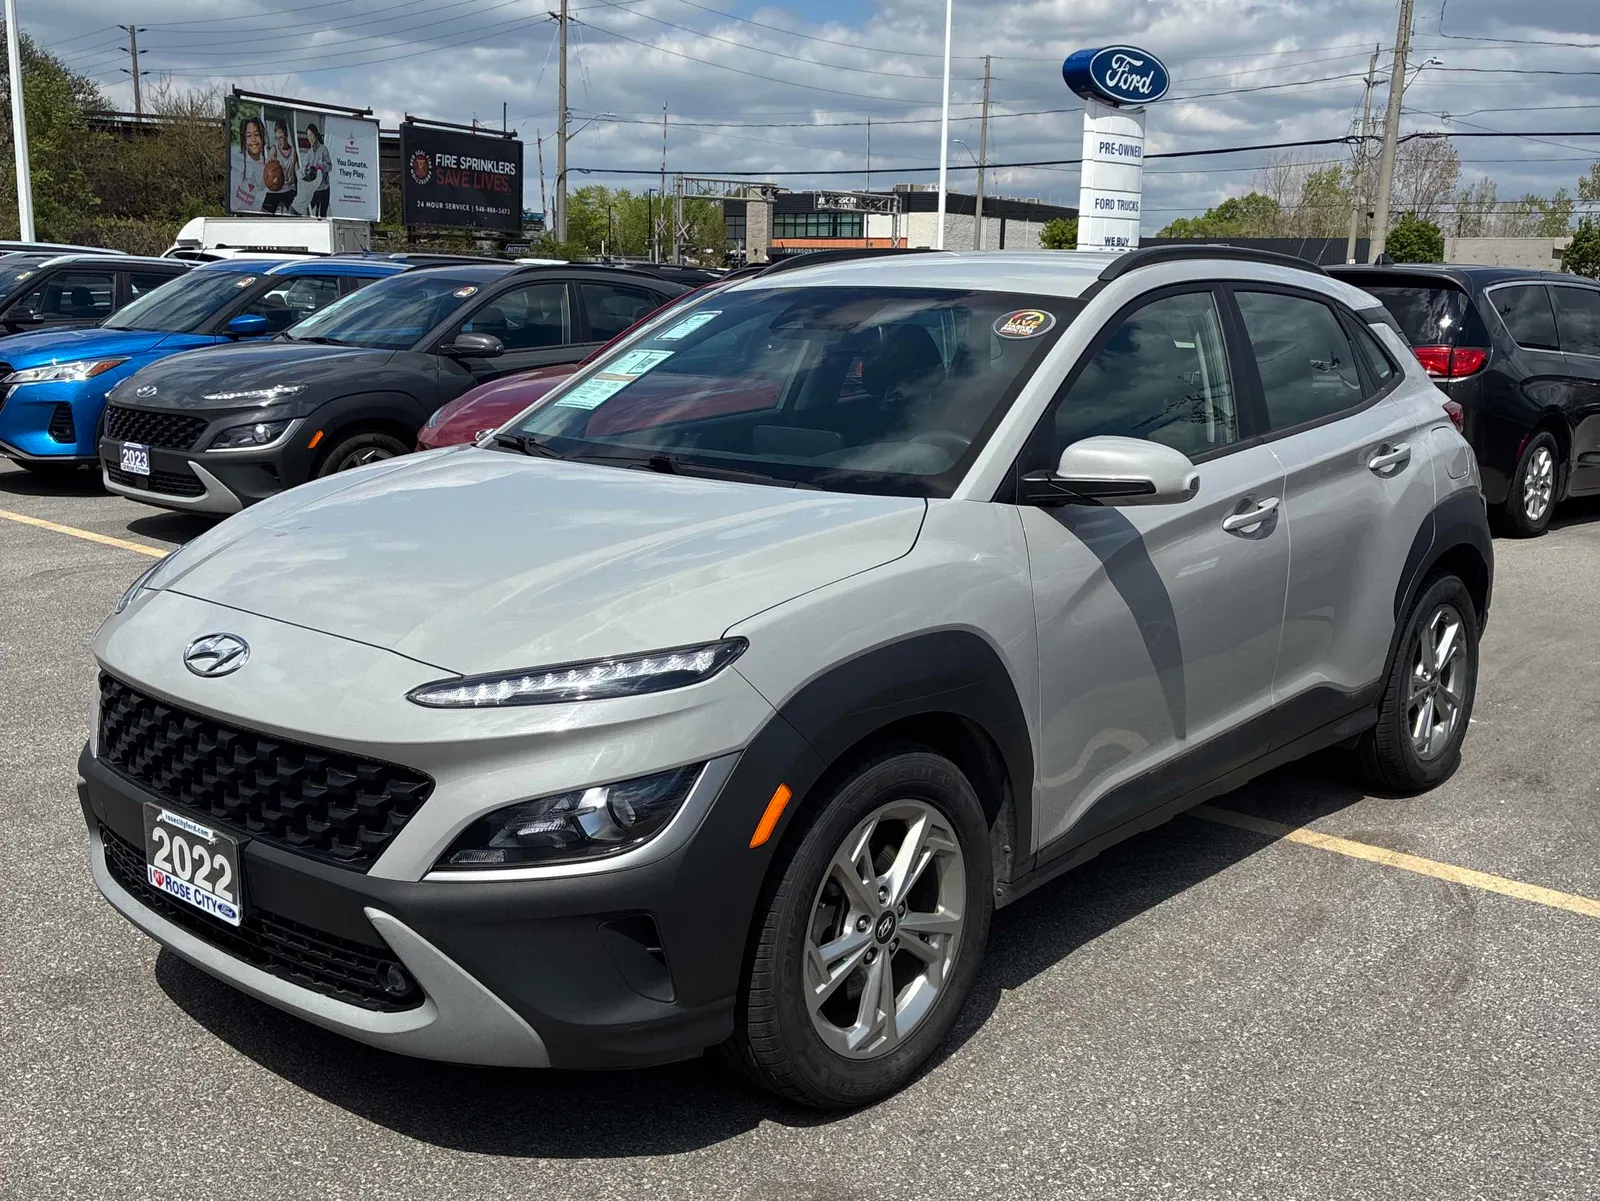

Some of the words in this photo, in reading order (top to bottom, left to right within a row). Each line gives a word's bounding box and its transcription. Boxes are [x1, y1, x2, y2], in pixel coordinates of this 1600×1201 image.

[1106, 54, 1154, 94] Ford
[1099, 142, 1141, 158] PRE-OWNED
[336, 157, 347, 167] You
[347, 159, 368, 169] Donate.
[435, 153, 457, 169] FIRE
[460, 156, 516, 175] SPRINKLERS
[339, 168, 352, 178] They
[352, 170, 366, 179] Play.
[436, 168, 470, 188] SAVE
[473, 173, 512, 193] LIVES.
[416, 200, 424, 208] 24
[426, 201, 444, 209] HOUR
[445, 203, 470, 211] SERVICE
[1095, 198, 1115, 210] FORD
[1117, 199, 1139, 212] TRUCKS
[1104, 236, 1115, 246] WE
[1116, 237, 1130, 247] BUY
[122, 448, 148, 468] 2023
[165, 814, 209, 838] rosecityford.com
[152, 826, 233, 903] 2022
[165, 875, 192, 901] ROSE
[194, 888, 218, 912] CITY
